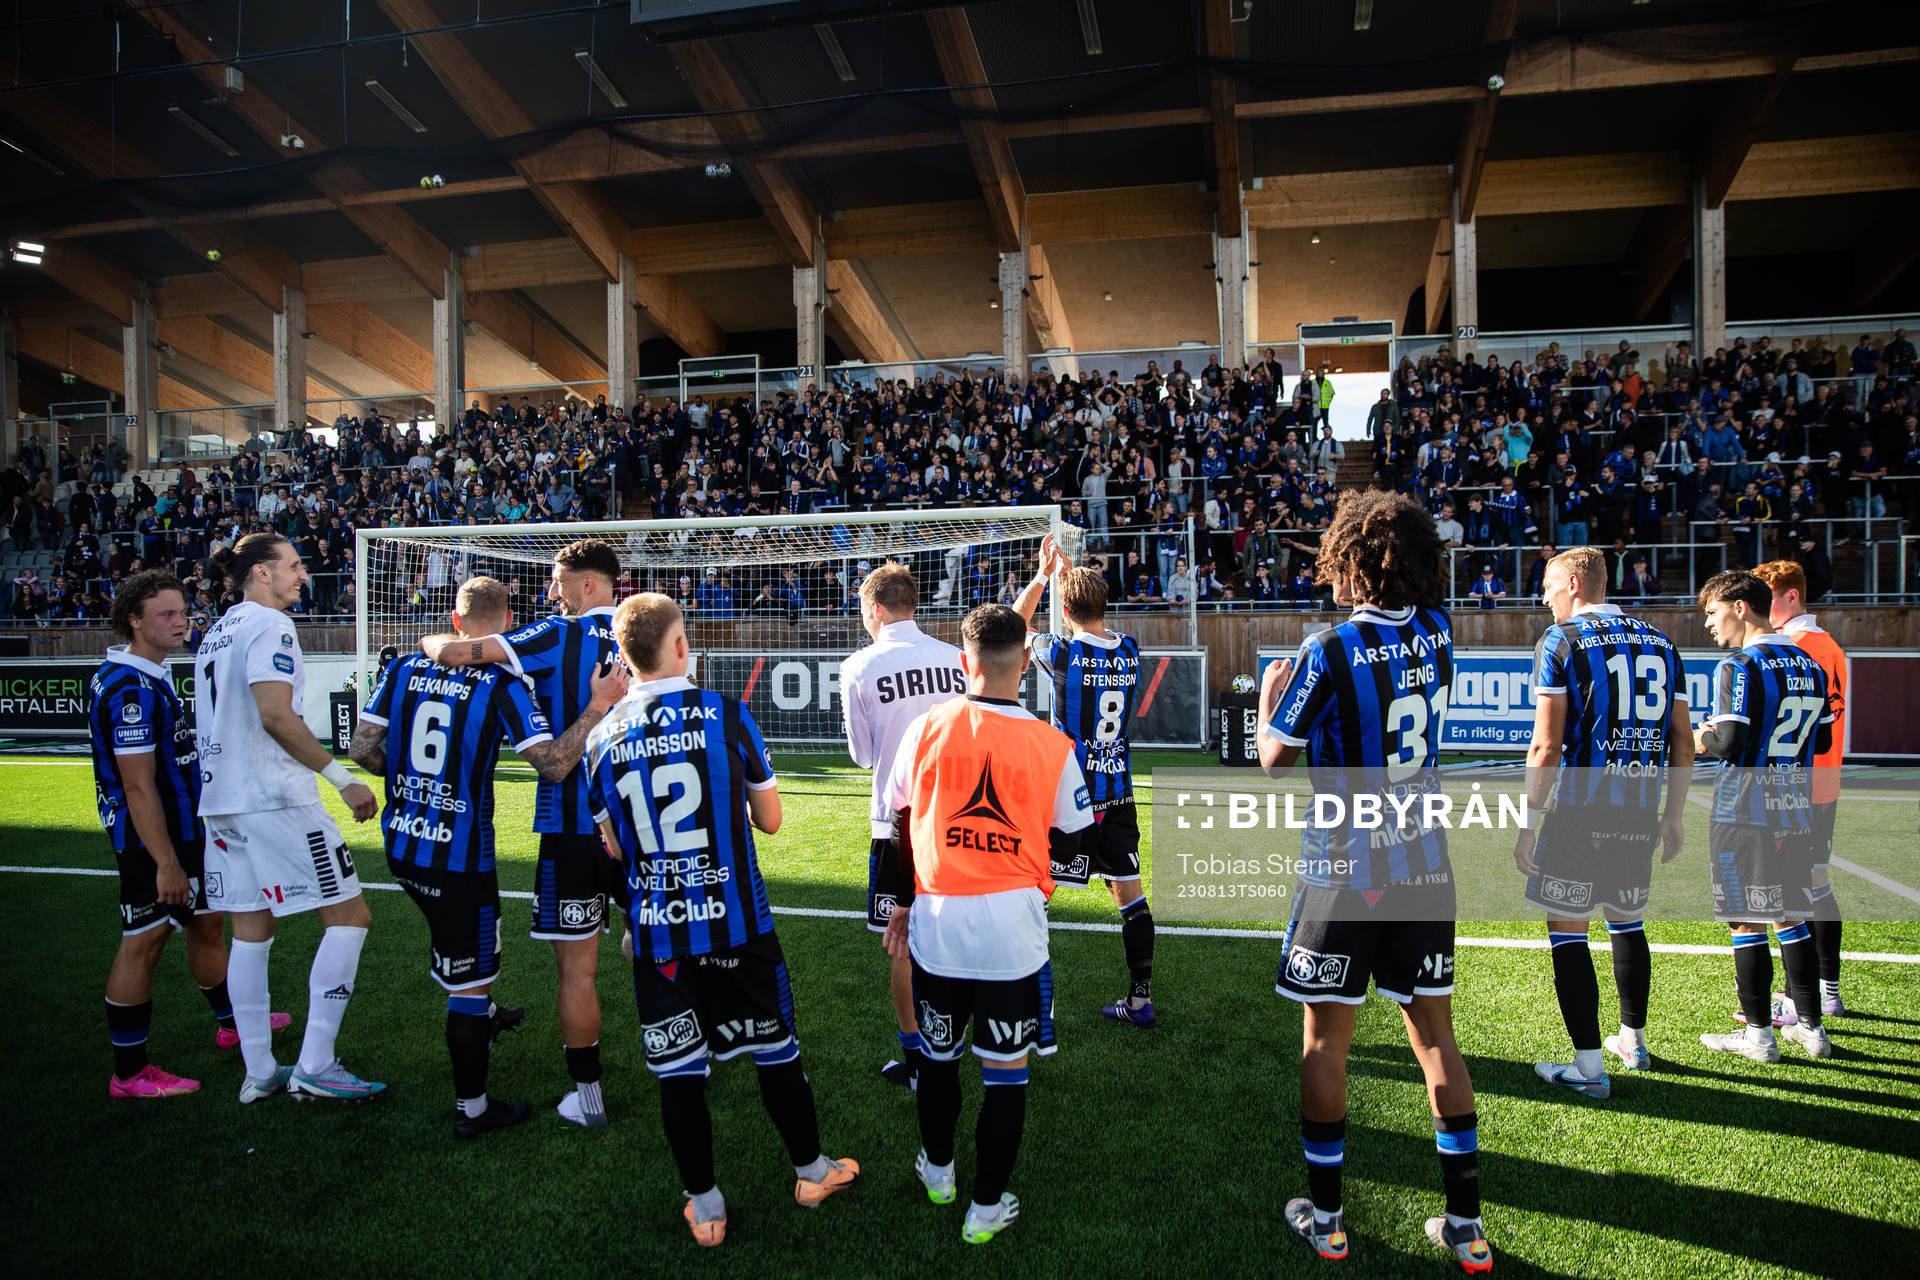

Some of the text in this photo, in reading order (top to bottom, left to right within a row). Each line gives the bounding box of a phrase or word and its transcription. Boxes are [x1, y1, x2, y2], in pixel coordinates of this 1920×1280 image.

[1458, 326, 1476, 339] 20
[799, 366, 814, 377] 21
[126, 416, 137, 426] 22
[1071, 654, 1113, 668] ÅRSTA
[1353, 629, 1451, 667] ÅRSTA TAK
[0, 679, 83, 697] ICKERI
[204, 660, 218, 717] 1
[408, 676, 472, 701] DEKAMPS
[466, 666, 496, 685] TAK
[876, 667, 967, 704] SIRIUS
[1083, 673, 1137, 687] STENSSON
[1397, 663, 1436, 691] JENG
[1606, 653, 1667, 721] 13
[1285, 670, 1320, 727] stadium
[1733, 672, 1746, 712] stadium
[338, 703, 352, 750] SELECT
[678, 706, 718, 721] TAK
[1095, 690, 1125, 741] 8
[1767, 696, 1825, 757] 27
[117, 728, 150, 738] UNIBET
[410, 700, 452, 776] 6
[610, 730, 707, 765] OMARSSON
[1243, 708, 1259, 760] SELECT
[1386, 684, 1449, 783] 31
[1451, 726, 1468, 738] En
[1471, 726, 1505, 741] riktig
[1613, 727, 1661, 740] NORDIC
[397, 773, 453, 797] NORDIC
[616, 761, 710, 855] 12
[388, 808, 454, 844] inkClub
[945, 826, 1022, 857] SELECT
[628, 866, 731, 892] WELLNESS
[639, 854, 711, 876] NORDIC
[638, 895, 727, 926] inkClub
